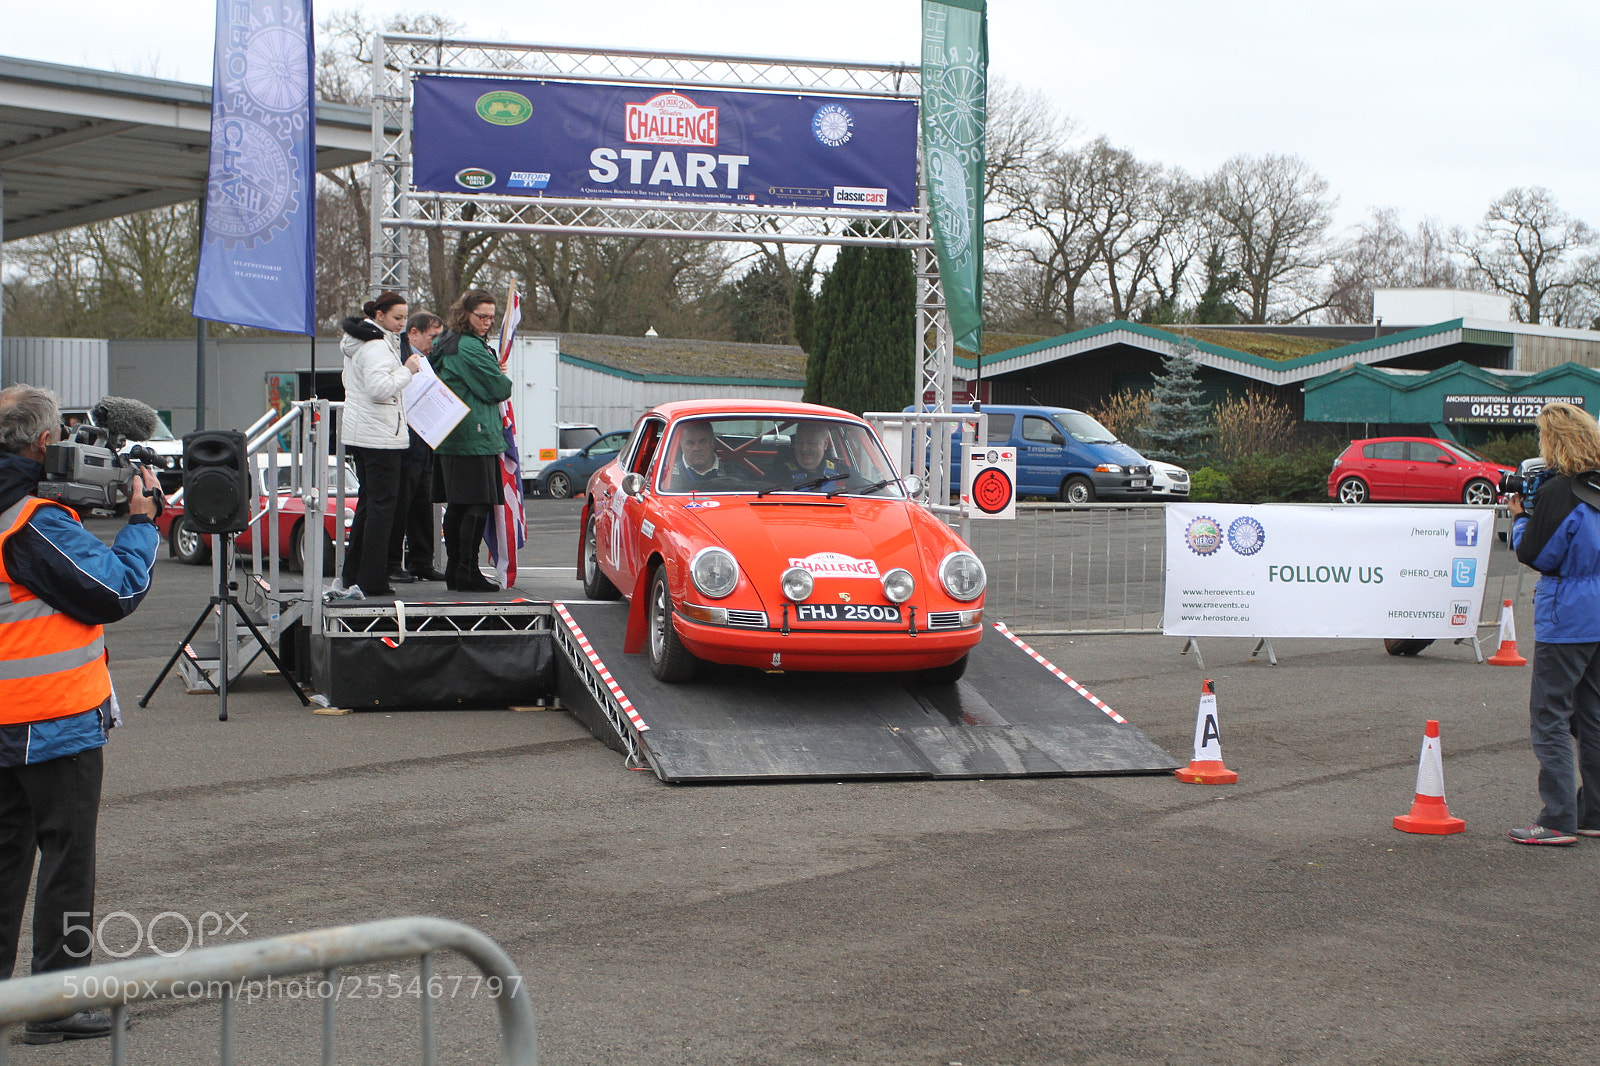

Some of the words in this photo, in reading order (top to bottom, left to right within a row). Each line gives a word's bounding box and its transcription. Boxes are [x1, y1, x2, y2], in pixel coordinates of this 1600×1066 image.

[814, 105, 836, 127] CLASSIC
[837, 106, 854, 127] RALLY
[628, 107, 715, 145] CHALLENGE
[815, 129, 854, 147] ASSOCIATION
[588, 147, 750, 190] START
[512, 173, 549, 181] MOTORS
[1445, 395, 1470, 403] ANCHOR
[1470, 396, 1506, 404] EXHIBITIONS
[1506, 396, 1512, 404] &
[1511, 396, 1545, 404] ELECTRICAL
[1544, 396, 1571, 404] SERVICES
[1471, 403, 1510, 417] 01455
[1411, 527, 1450, 539] /herorally
[1268, 565, 1352, 584] FOLLOW
[1358, 566, 1385, 584] US
[1399, 568, 1449, 580] @HERO_CRA
[1182, 588, 1256, 596] www.heroevents.eu
[798, 605, 838, 620] FHJ
[843, 606, 899, 621] 250D
[1388, 610, 1446, 619] HEROEVENTSEU
[1454, 603, 1468, 614] You
[1181, 614, 1250, 622] www.herostore.eu
[1452, 615, 1467, 624] Tube
[1201, 713, 1221, 748] A
